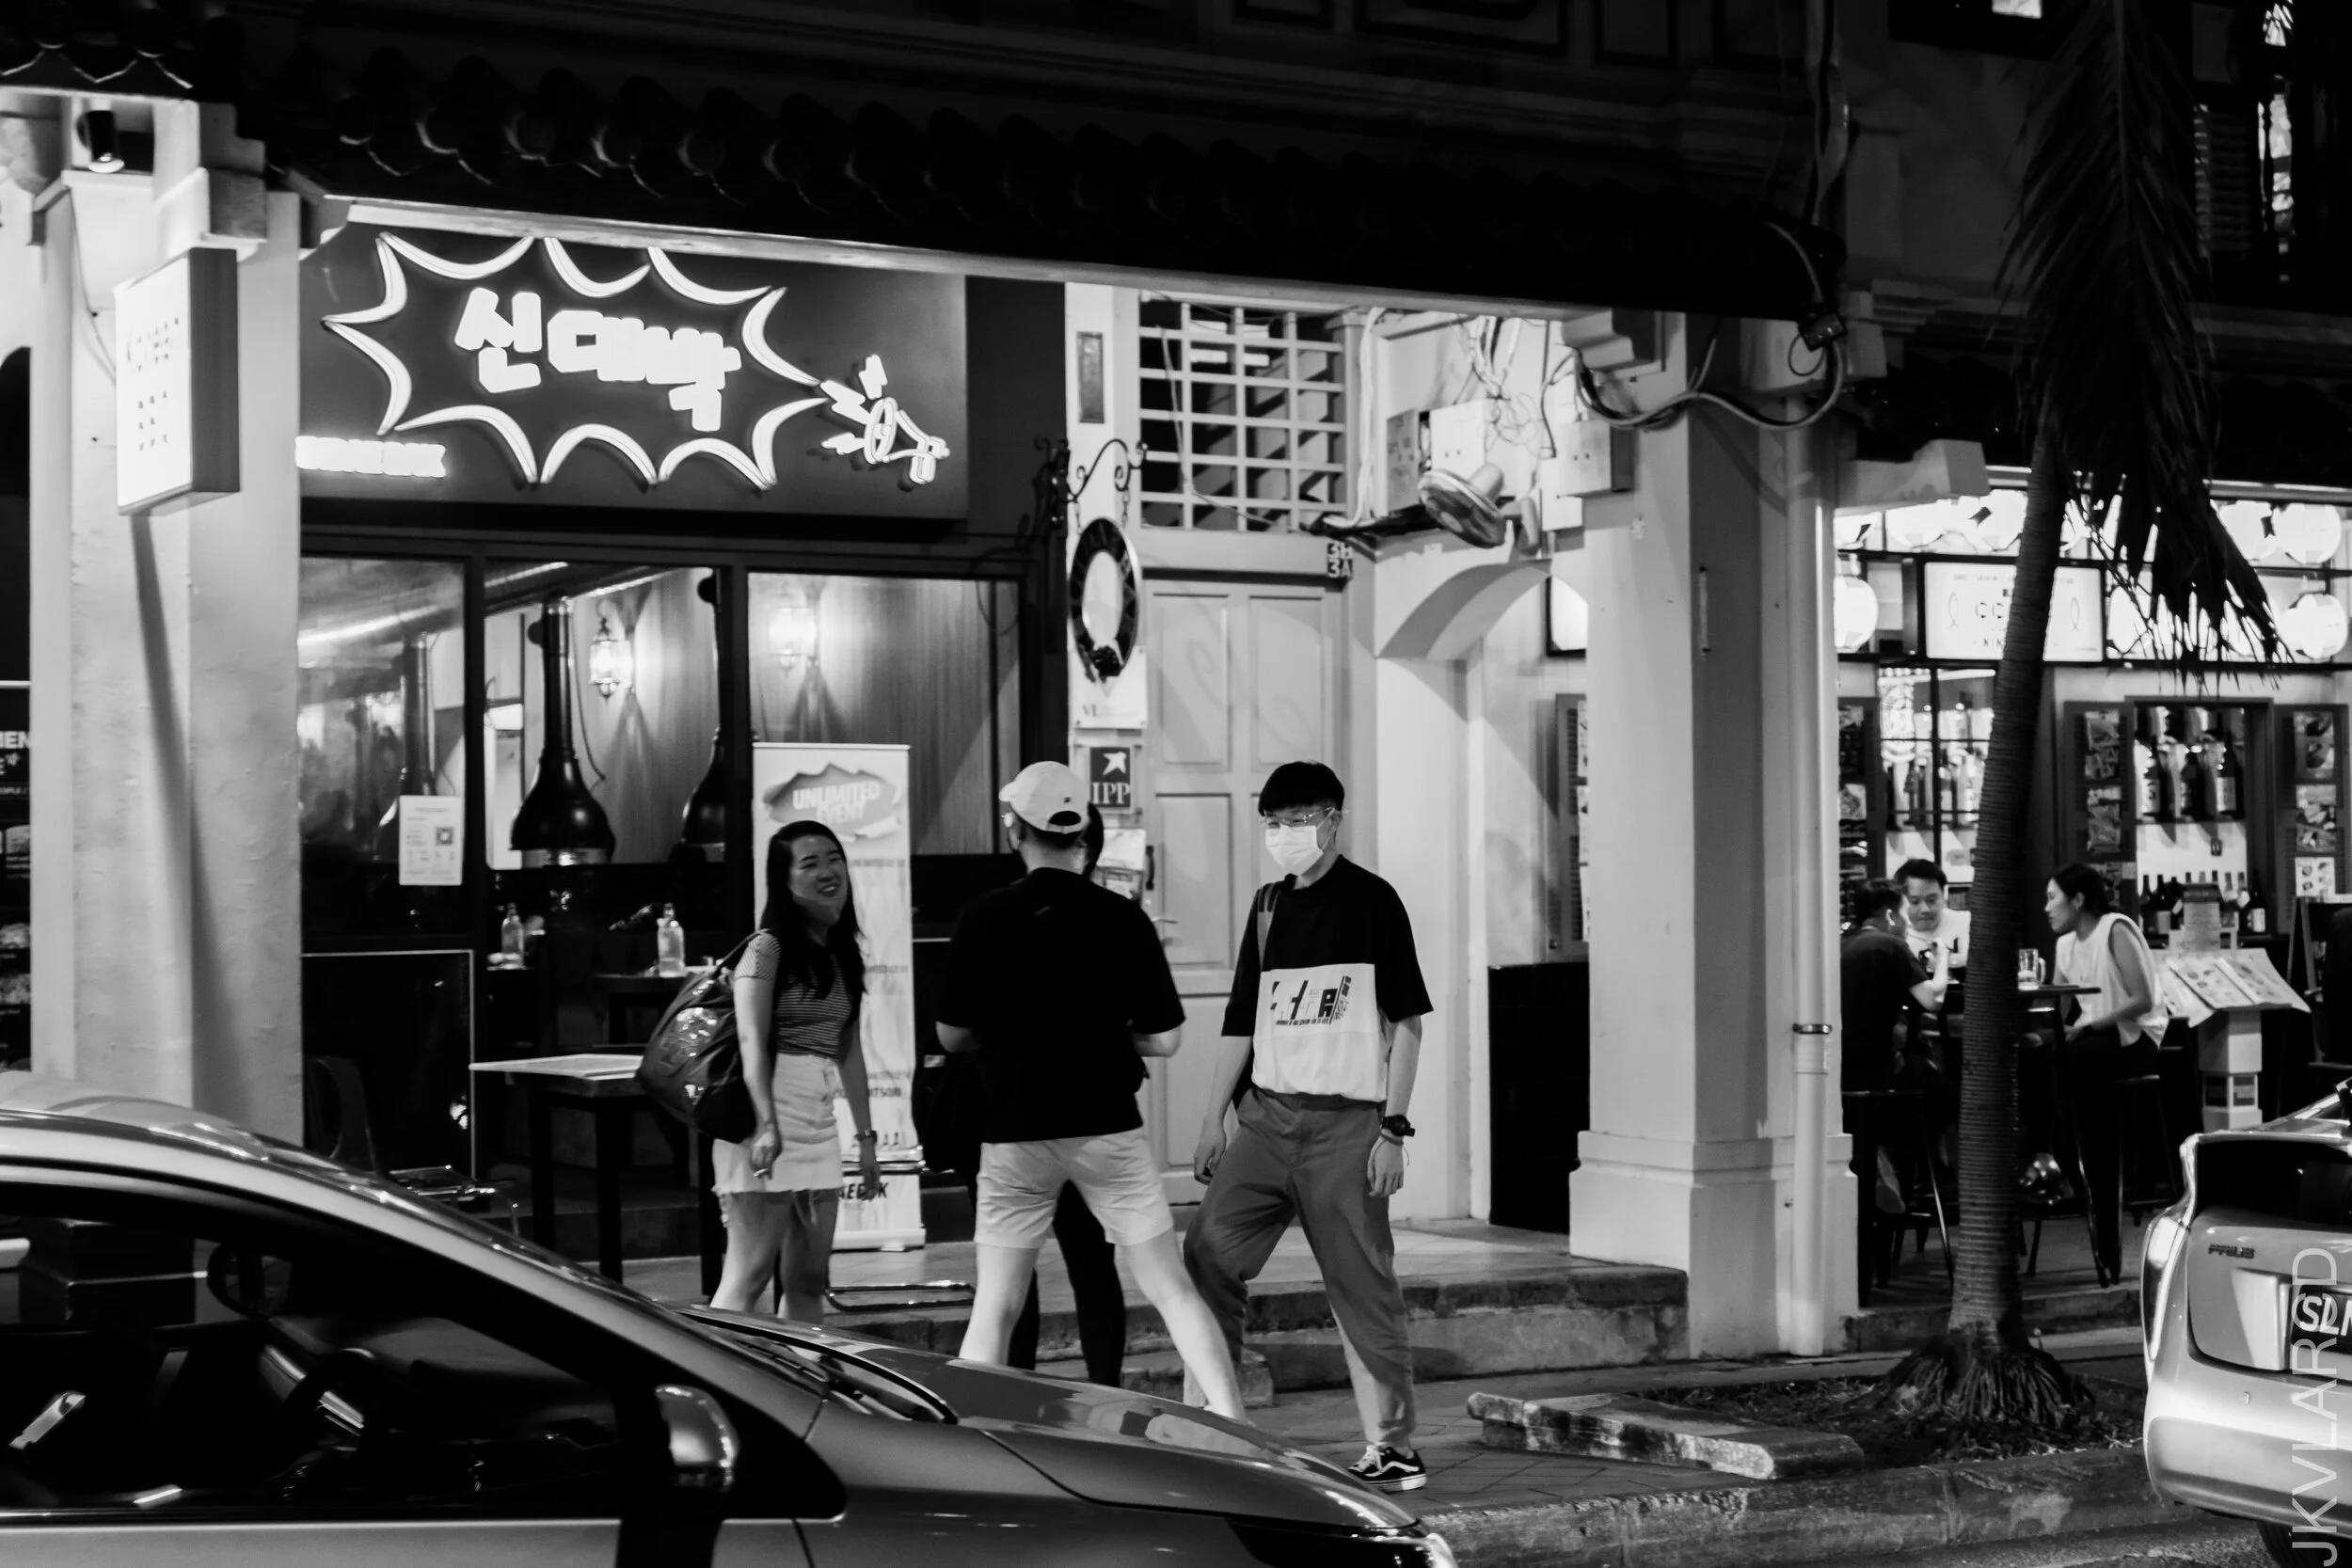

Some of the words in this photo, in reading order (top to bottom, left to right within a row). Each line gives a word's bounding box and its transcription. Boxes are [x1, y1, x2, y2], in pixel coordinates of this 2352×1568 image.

[1327, 558, 1353, 578] 3A
[792, 779, 881, 810] UNLIMITED
[1091, 781, 1131, 805] IPP
[816, 800, 866, 824] EVENT
[2207, 1243, 2255, 1259] PRIUS
